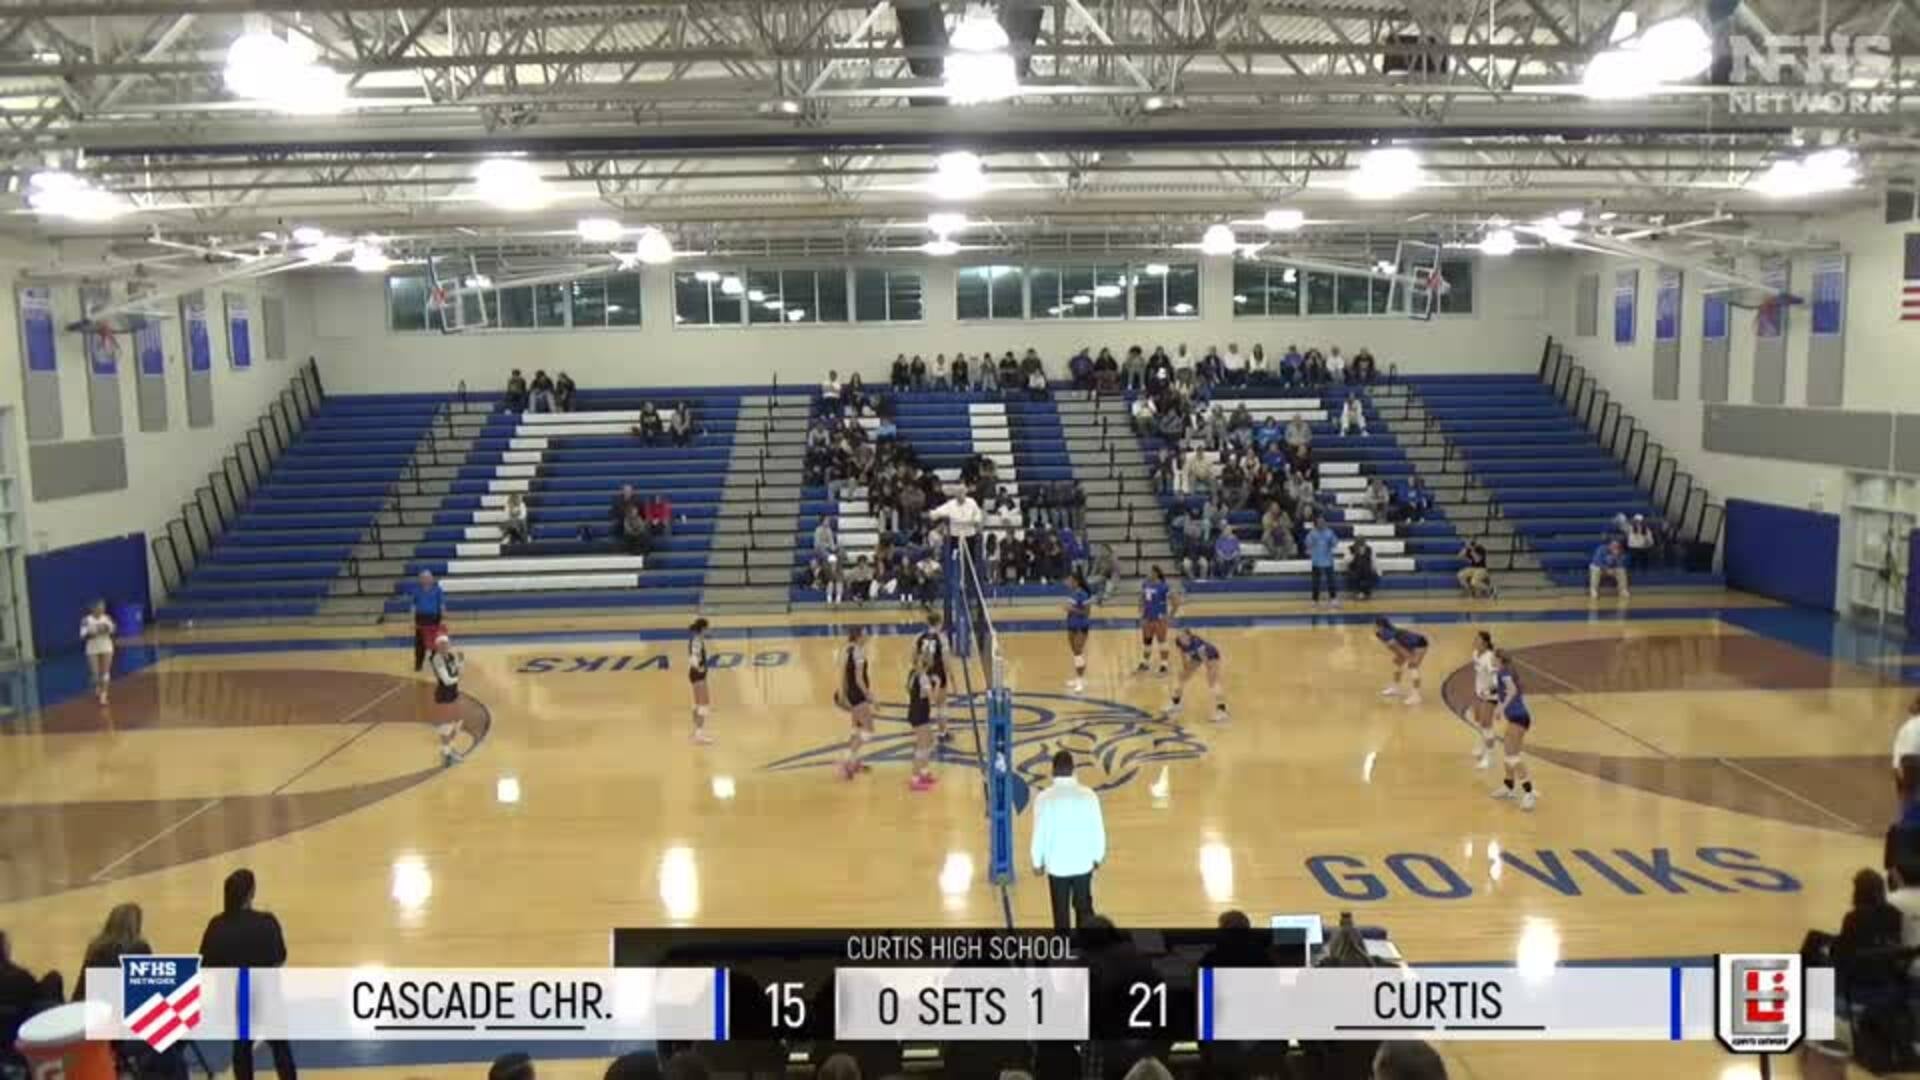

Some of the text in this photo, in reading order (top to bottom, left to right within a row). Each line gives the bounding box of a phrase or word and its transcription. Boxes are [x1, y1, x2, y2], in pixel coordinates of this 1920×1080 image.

[516, 655, 671, 673] VIKS
[1305, 848, 1801, 900] GO VIKS
